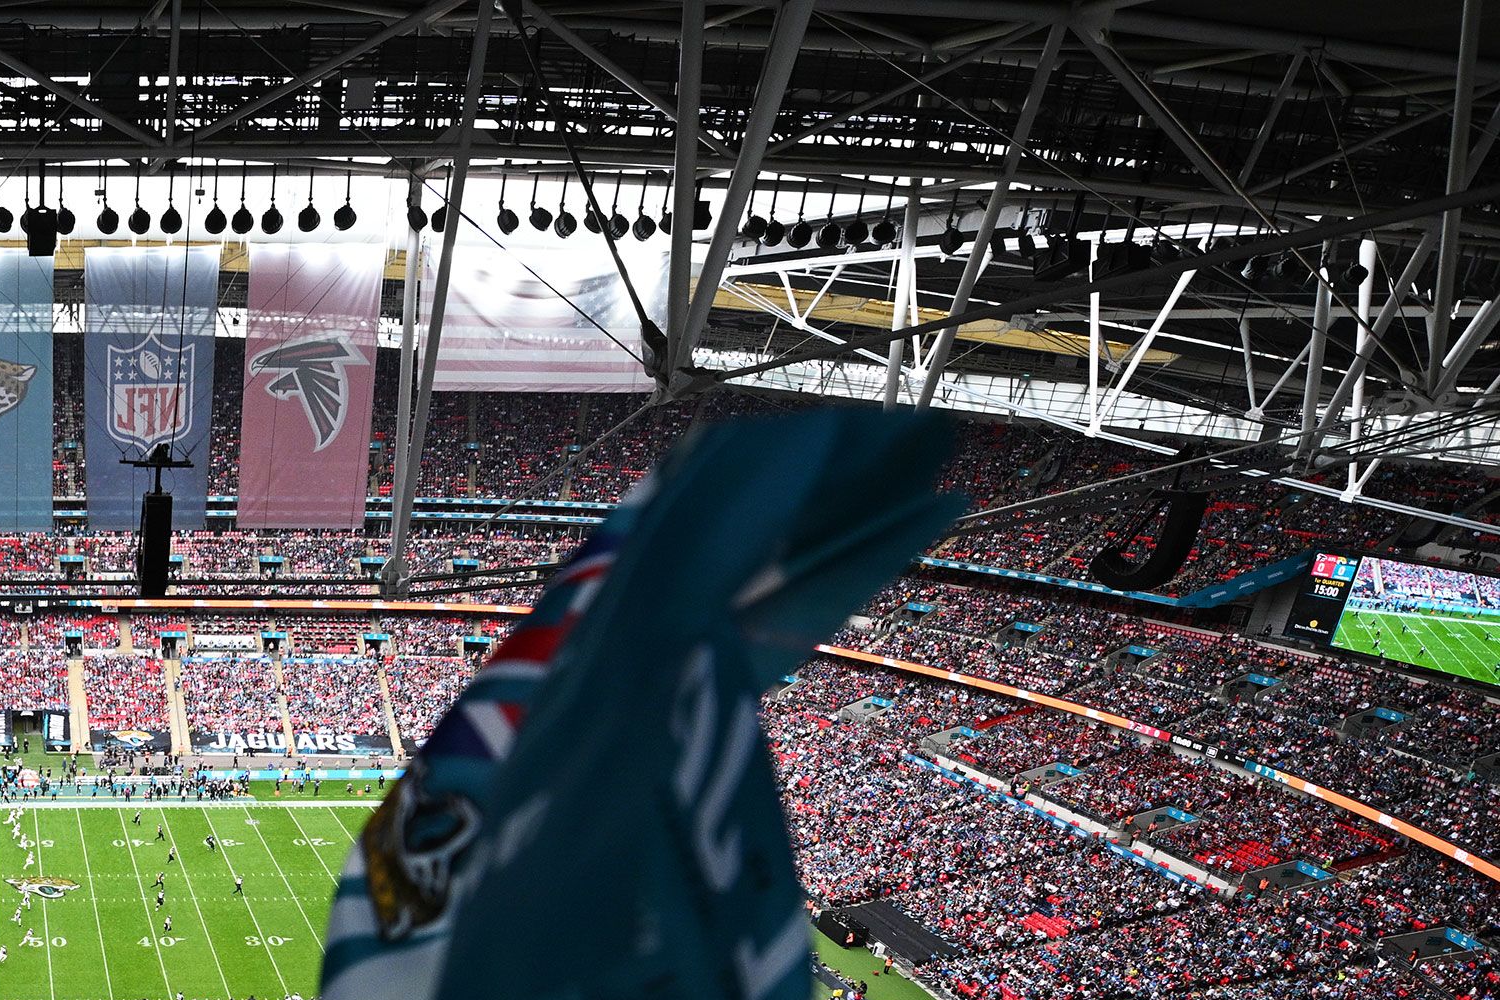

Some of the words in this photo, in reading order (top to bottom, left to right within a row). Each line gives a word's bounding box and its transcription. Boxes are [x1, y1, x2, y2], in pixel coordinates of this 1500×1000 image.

[1317, 563, 1326, 572] 0
[1338, 566, 1347, 576] 0
[1314, 584, 1339, 597] 15:00
[209, 733, 357, 751] JAGUARS
[112, 840, 146, 849] 40
[28, 936, 67, 948] 50
[136, 936, 176, 947] 40
[244, 936, 284, 947] 30
